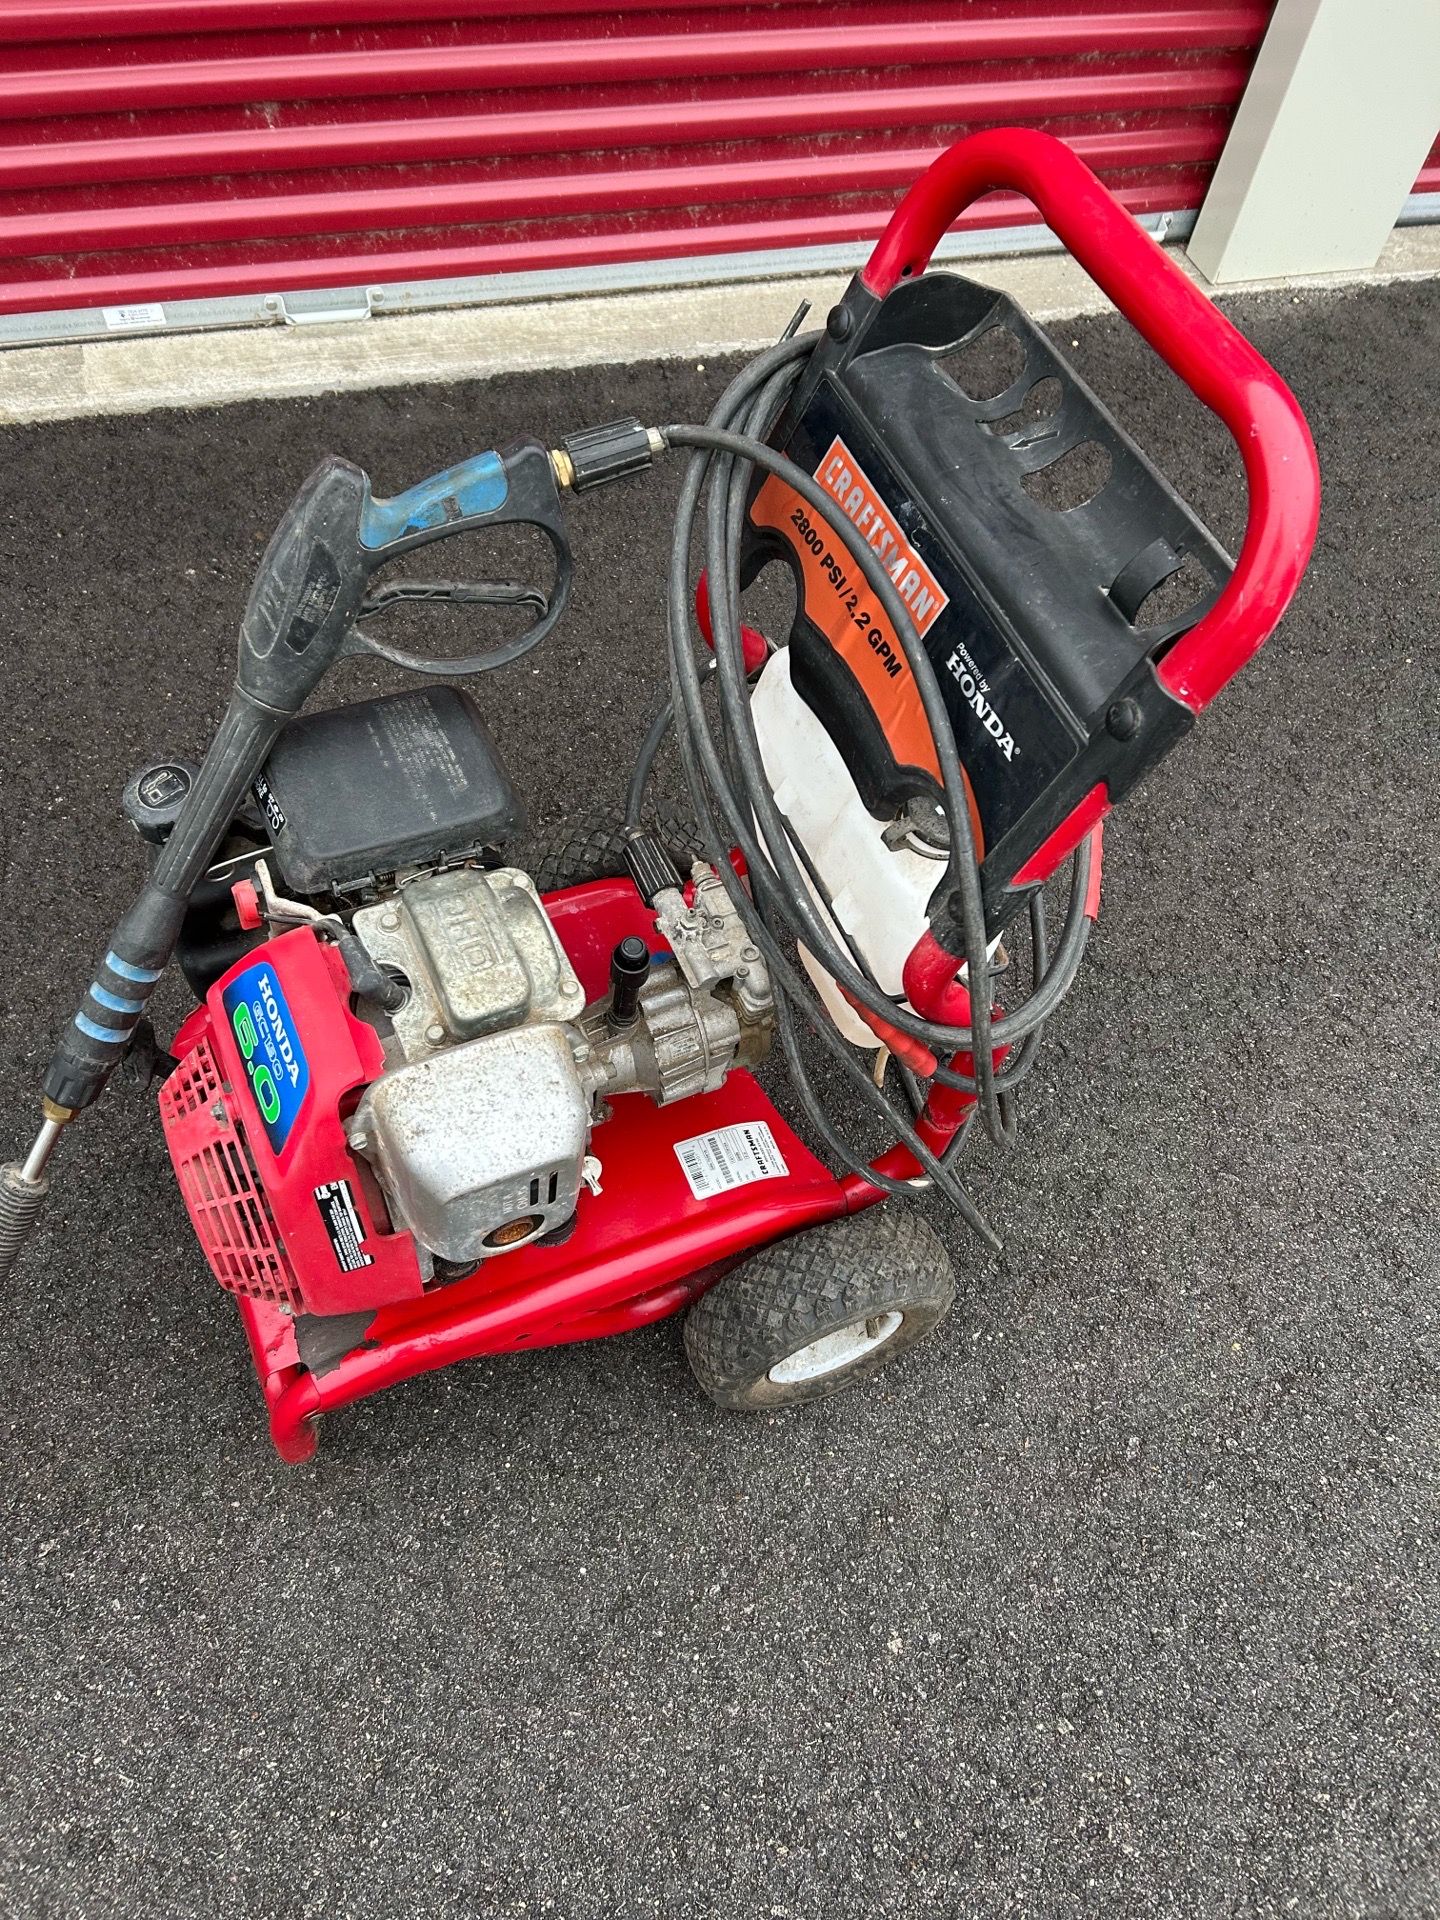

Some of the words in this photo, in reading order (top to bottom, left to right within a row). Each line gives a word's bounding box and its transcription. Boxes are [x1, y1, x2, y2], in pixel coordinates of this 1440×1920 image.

[790, 508, 824, 556] 2800
[867, 627, 903, 679] GPM
[824, 455, 935, 622] CRAFTSMAN
[945, 650, 1015, 762] HONDA
[956, 641, 984, 680] Powered
[978, 678, 991, 693] by
[233, 1001, 281, 1125] 6.0
[257, 972, 300, 1089] HONDA
[743, 1129, 769, 1175] CRAFTSMAN
